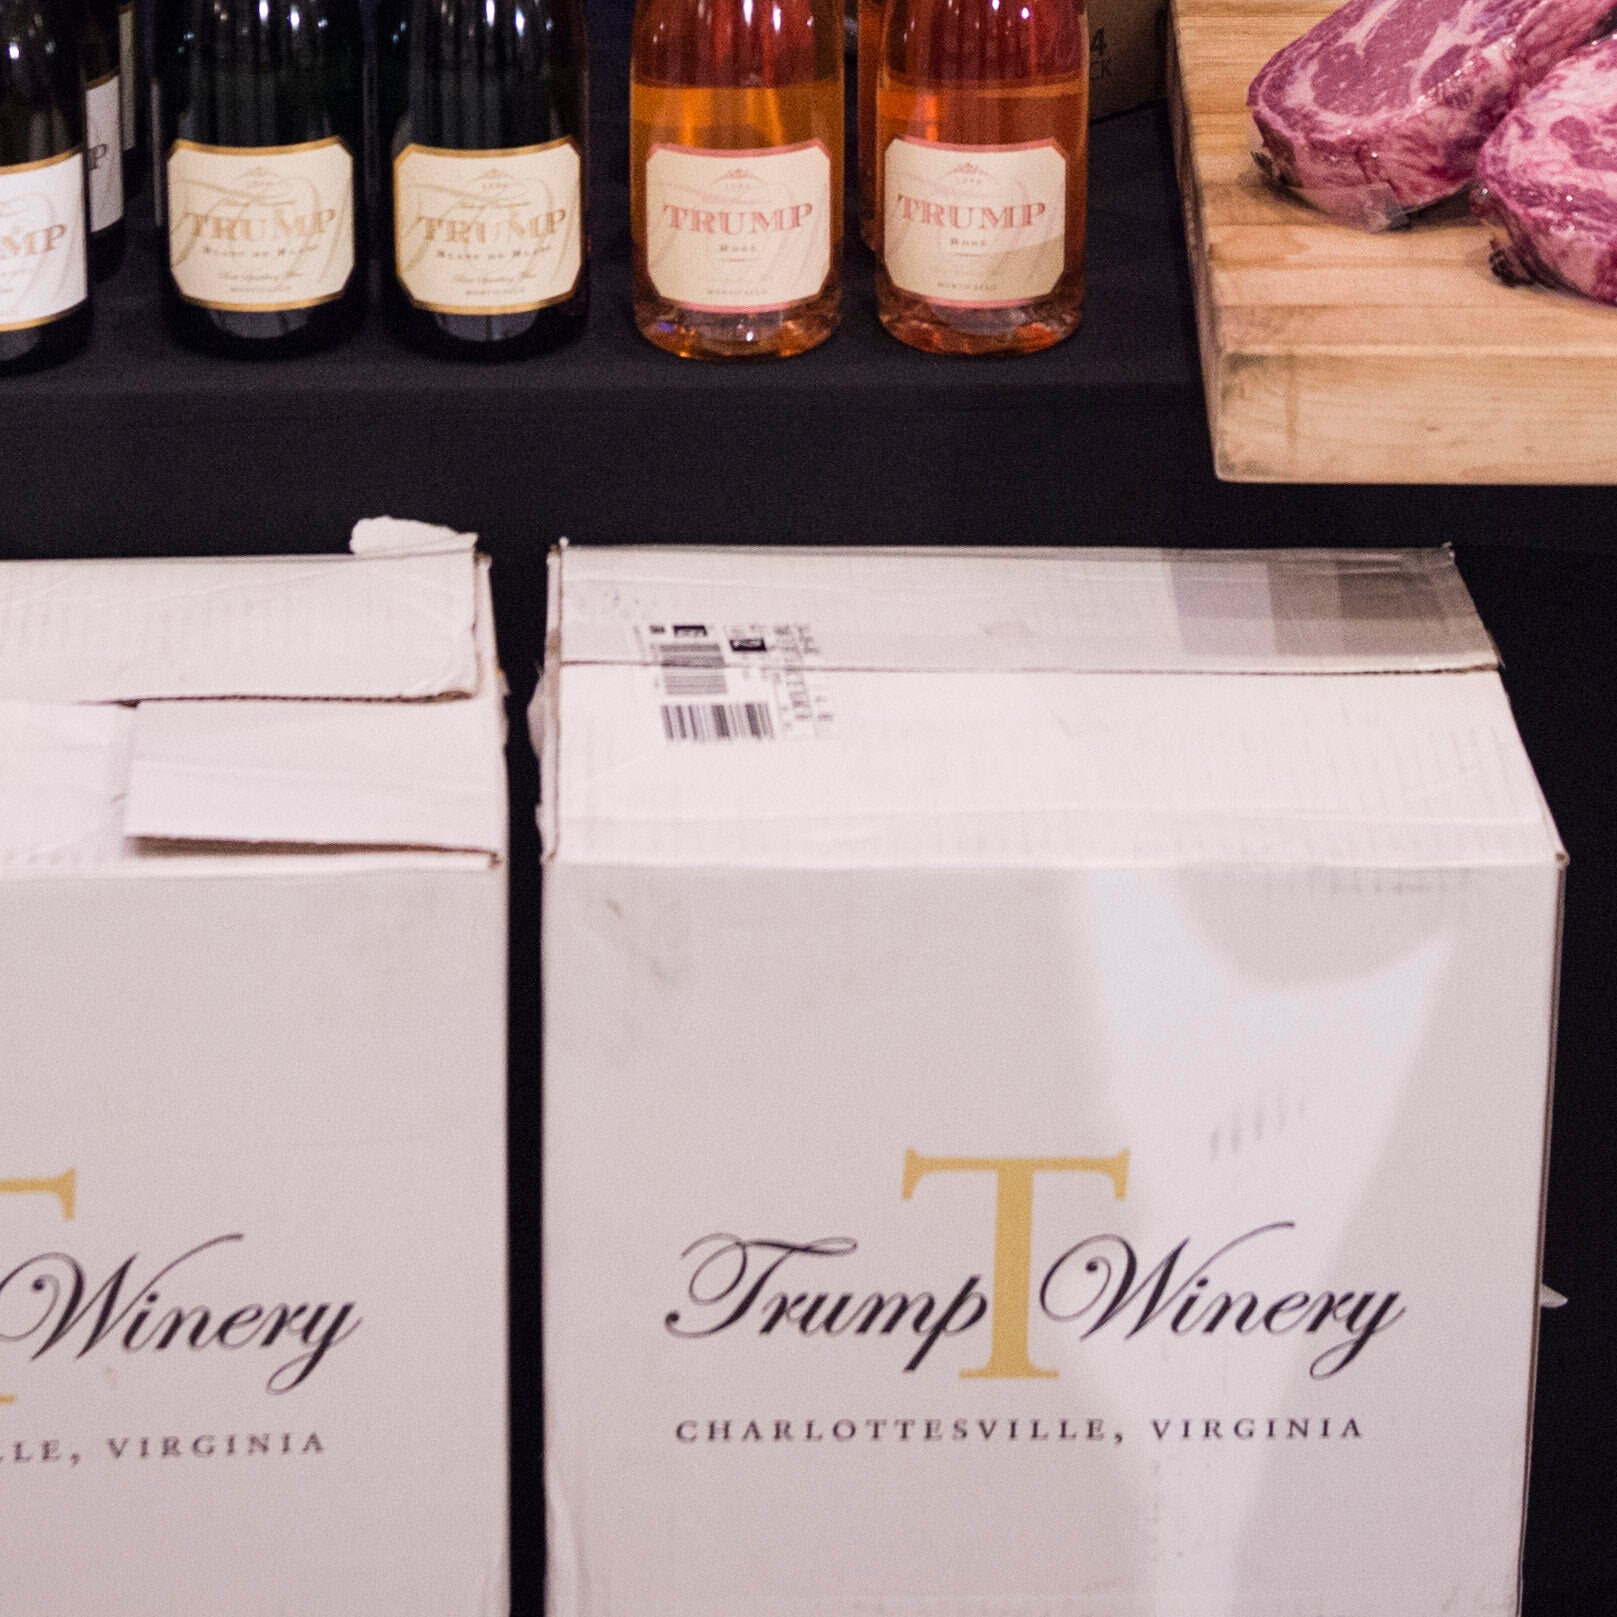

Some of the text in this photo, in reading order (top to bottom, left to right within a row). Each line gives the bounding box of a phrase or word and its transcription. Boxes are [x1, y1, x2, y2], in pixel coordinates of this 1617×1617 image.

[185, 208, 336, 242] TRUMP
[416, 208, 566, 243] TRUMP
[662, 201, 814, 236] TRUMP
[896, 193, 1047, 230] TRUMP
[901, 1148, 1131, 1379] T
[664, 1221, 1408, 1381] Trump Winery
[106, 1429, 327, 1462] VIRGINIA
[675, 1415, 1365, 1446] CHARLOTTESVILLE, VIRGINIA
